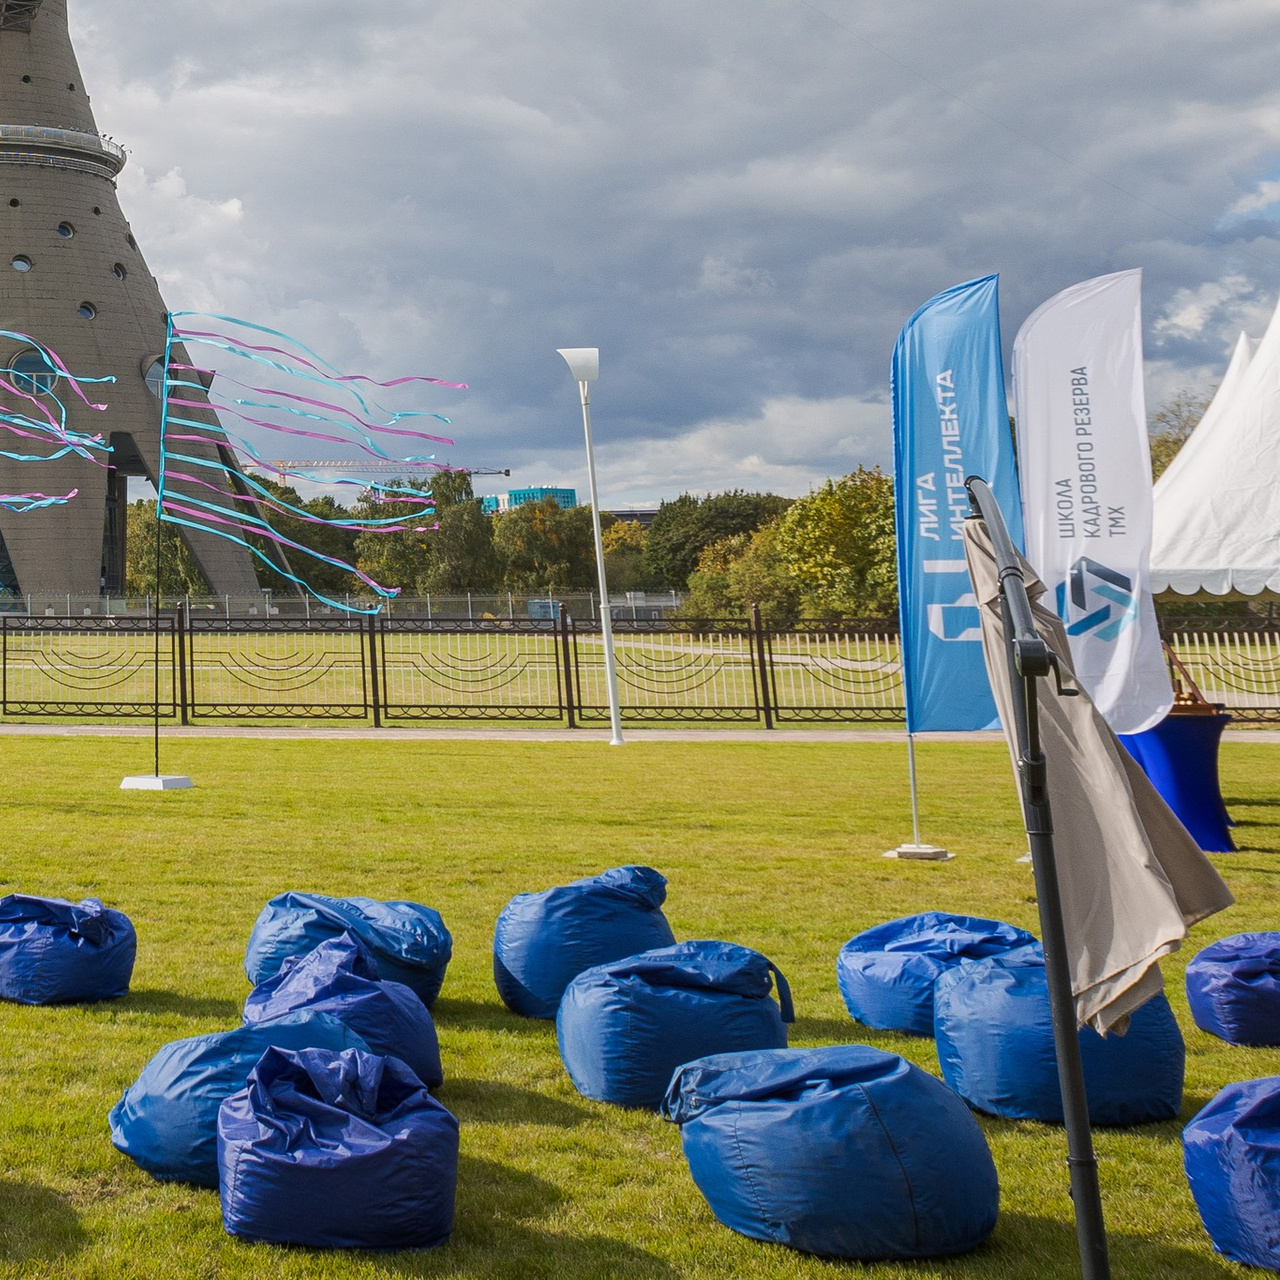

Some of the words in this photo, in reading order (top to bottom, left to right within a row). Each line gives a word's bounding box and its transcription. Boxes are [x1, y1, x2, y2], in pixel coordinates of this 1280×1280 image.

[1070, 366, 1093, 436] РЕЗЕРВА
[936, 369, 968, 541] ИНТЕЛЛЕКТА
[916, 472, 941, 541] ЛИГА
[1055, 478, 1075, 539] ШКОЛА
[1076, 442, 1102, 538] КАДРОВОГО
[1107, 505, 1127, 538] ТМХ
